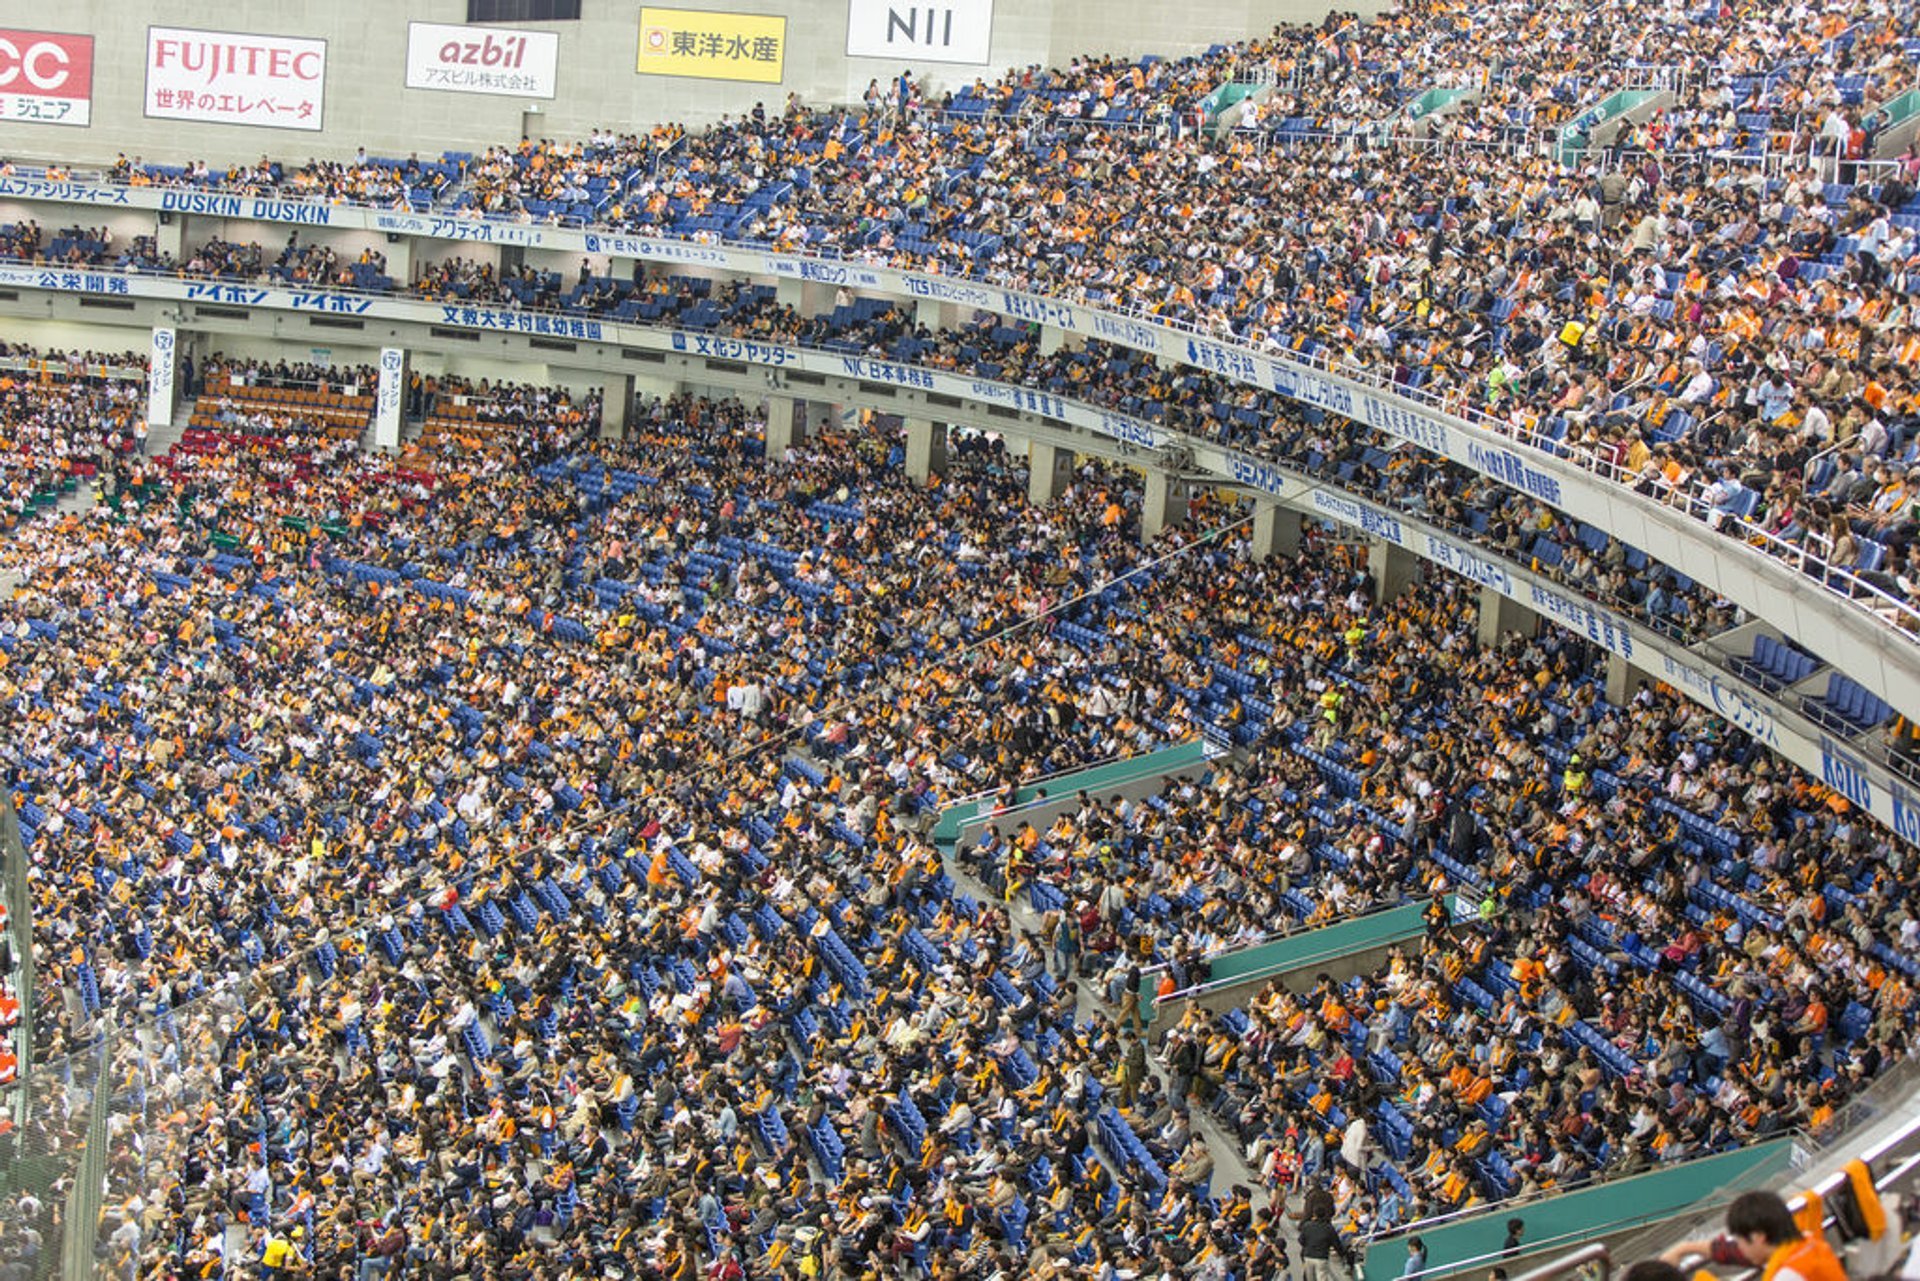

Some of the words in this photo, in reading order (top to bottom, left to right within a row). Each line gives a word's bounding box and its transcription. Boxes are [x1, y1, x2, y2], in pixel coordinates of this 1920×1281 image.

[887, 7, 952, 46] NII
[155, 41, 321, 85] FUJITEC
[439, 36, 527, 69] azbil
[671, 30, 778, 63] 東洋水産
[425, 68, 537, 91] アズビル株式会社
[17, 97, 72, 120] ジュニア
[155, 88, 315, 120] 世界のエレベータ
[38, 271, 130, 295] 公栄開発
[184, 281, 270, 305] アイホン
[288, 290, 374, 315] アイホン
[441, 305, 602, 340] 文教大学付属幼稚園
